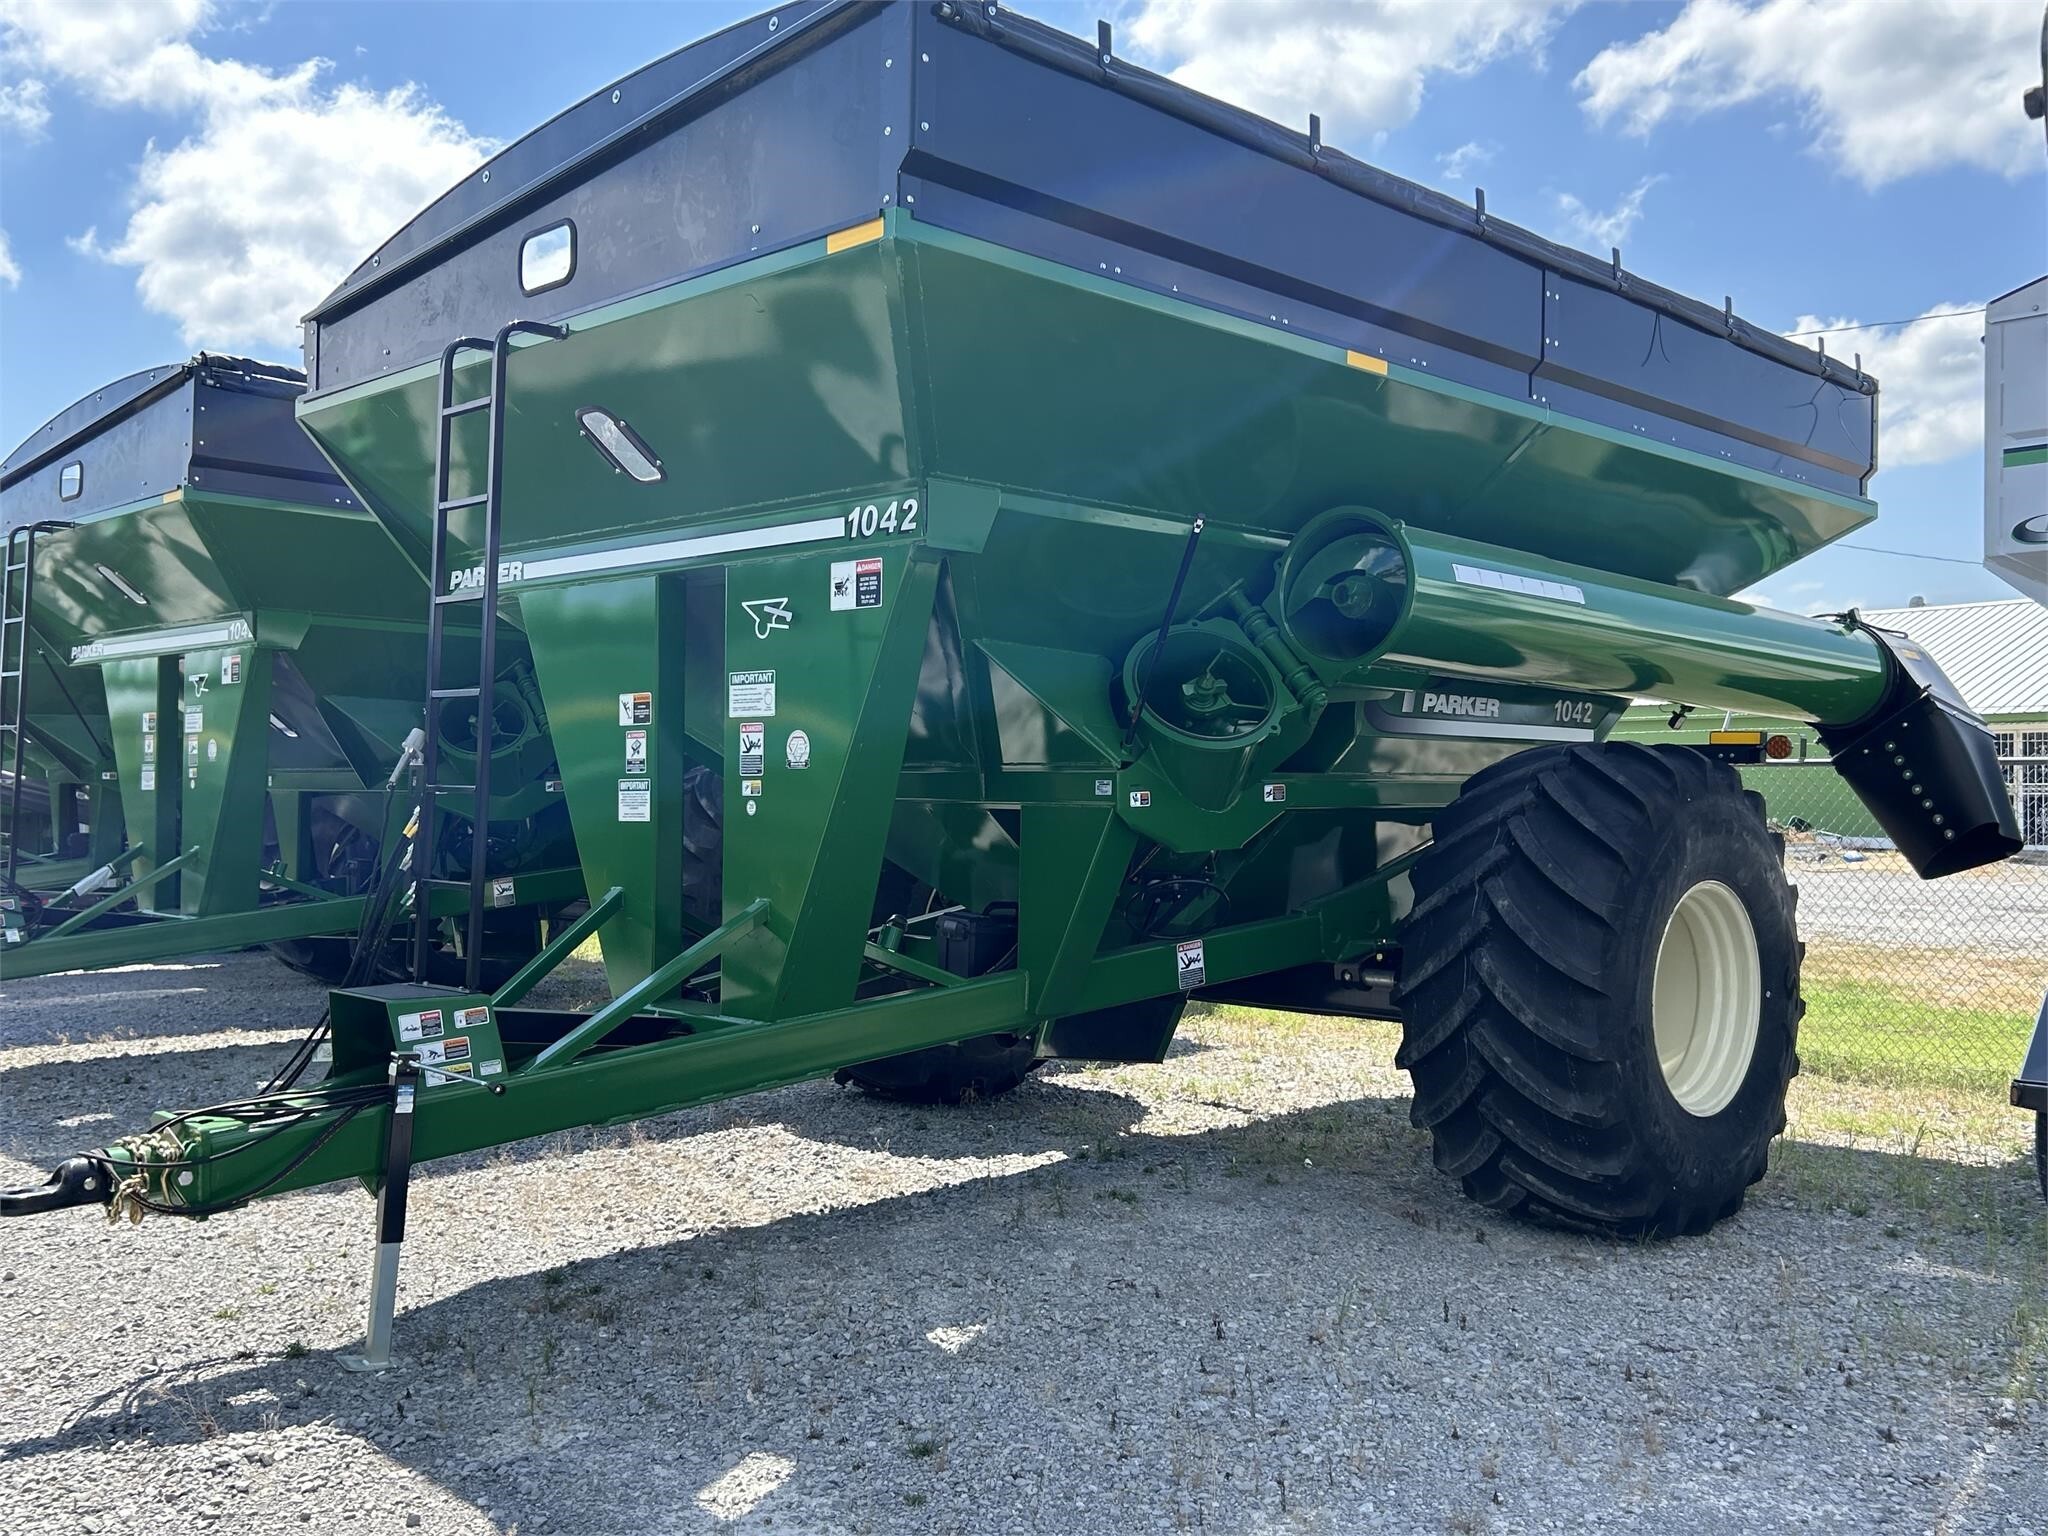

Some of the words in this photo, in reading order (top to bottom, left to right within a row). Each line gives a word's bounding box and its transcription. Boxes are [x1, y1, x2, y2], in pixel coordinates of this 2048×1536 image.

[848, 498, 918, 538] 1042
[449, 561, 523, 590] PARER
[731, 672, 773, 684] IMPORTANT
[1422, 693, 1500, 717] PARKER
[1554, 699, 1593, 723] 1042
[620, 781, 649, 790] IMPORTANT
